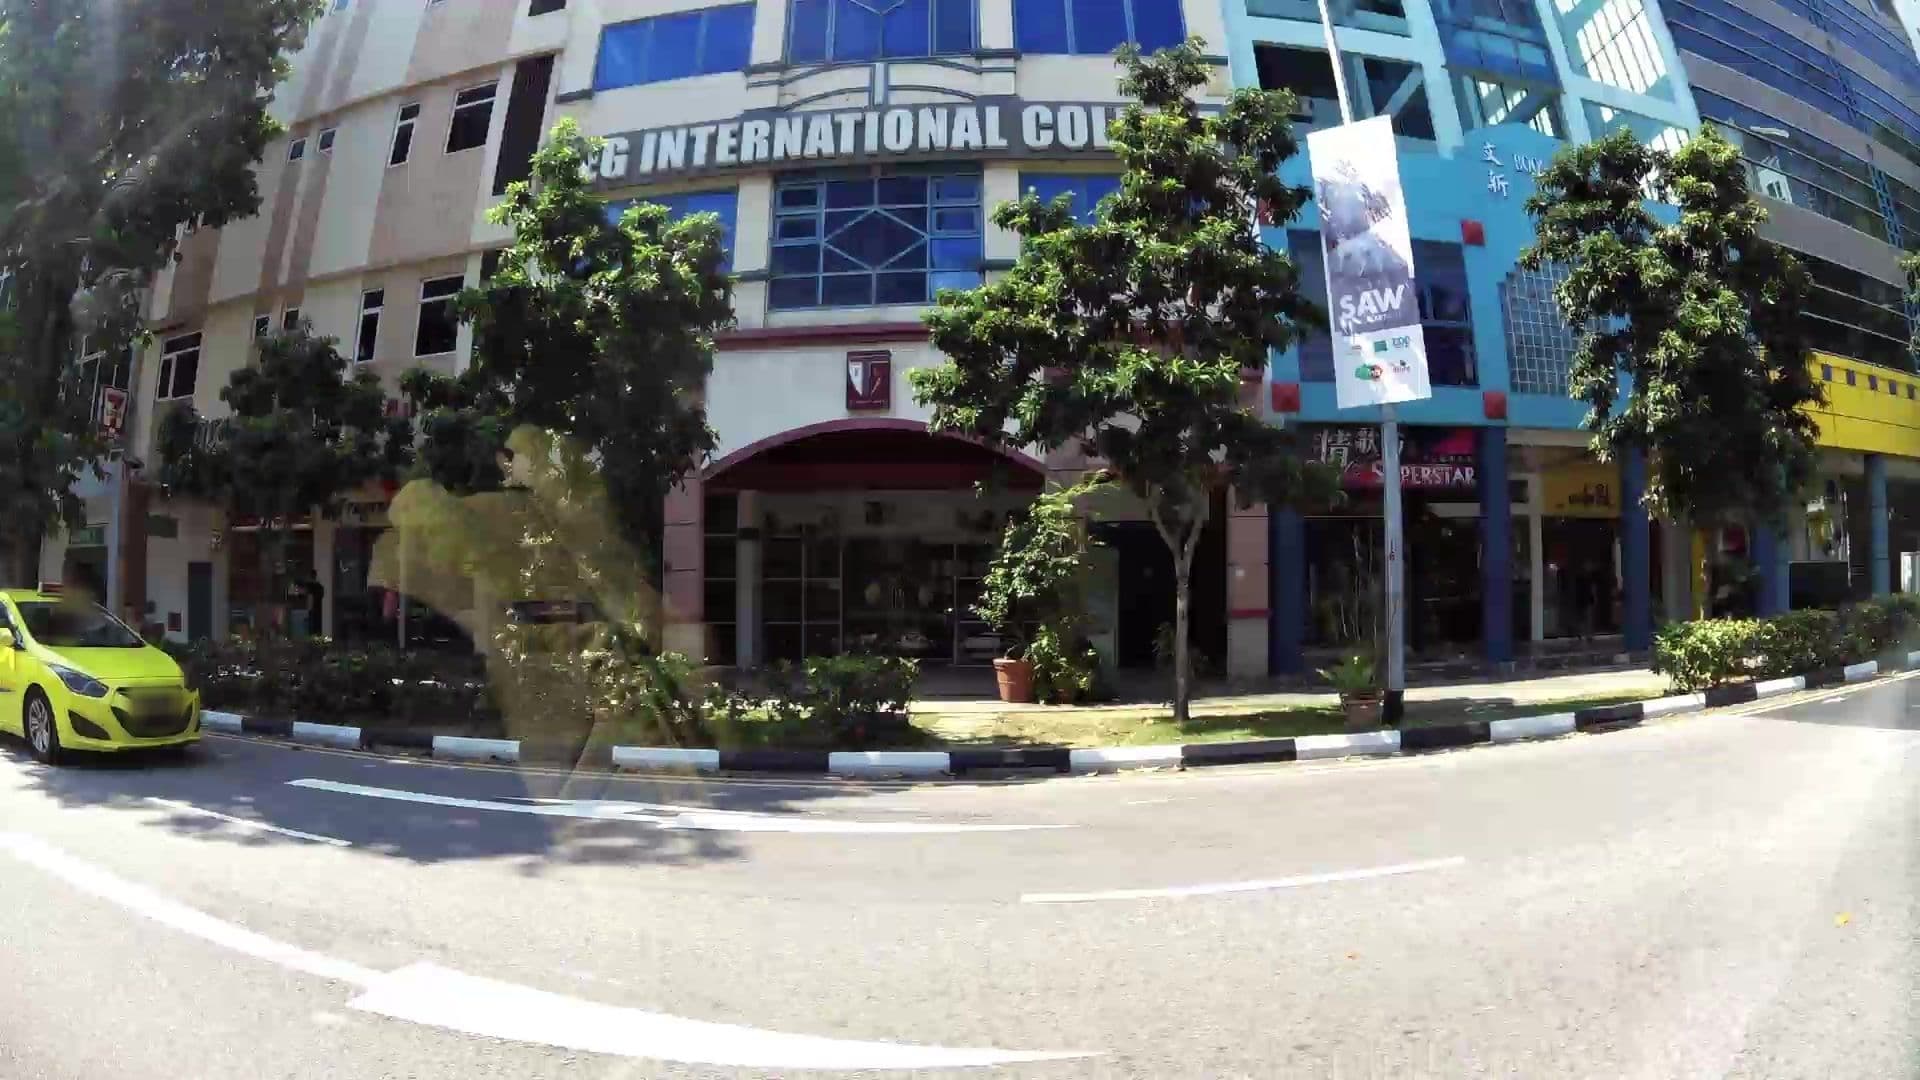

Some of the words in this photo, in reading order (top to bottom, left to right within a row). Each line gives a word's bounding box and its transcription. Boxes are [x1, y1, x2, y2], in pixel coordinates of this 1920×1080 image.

[639, 105, 1008, 174] INTERNATIONAL
[1021, 103, 1122, 152] COL
[1339, 285, 1405, 318] SAW
[1371, 462, 1476, 487] SPERSTAR
